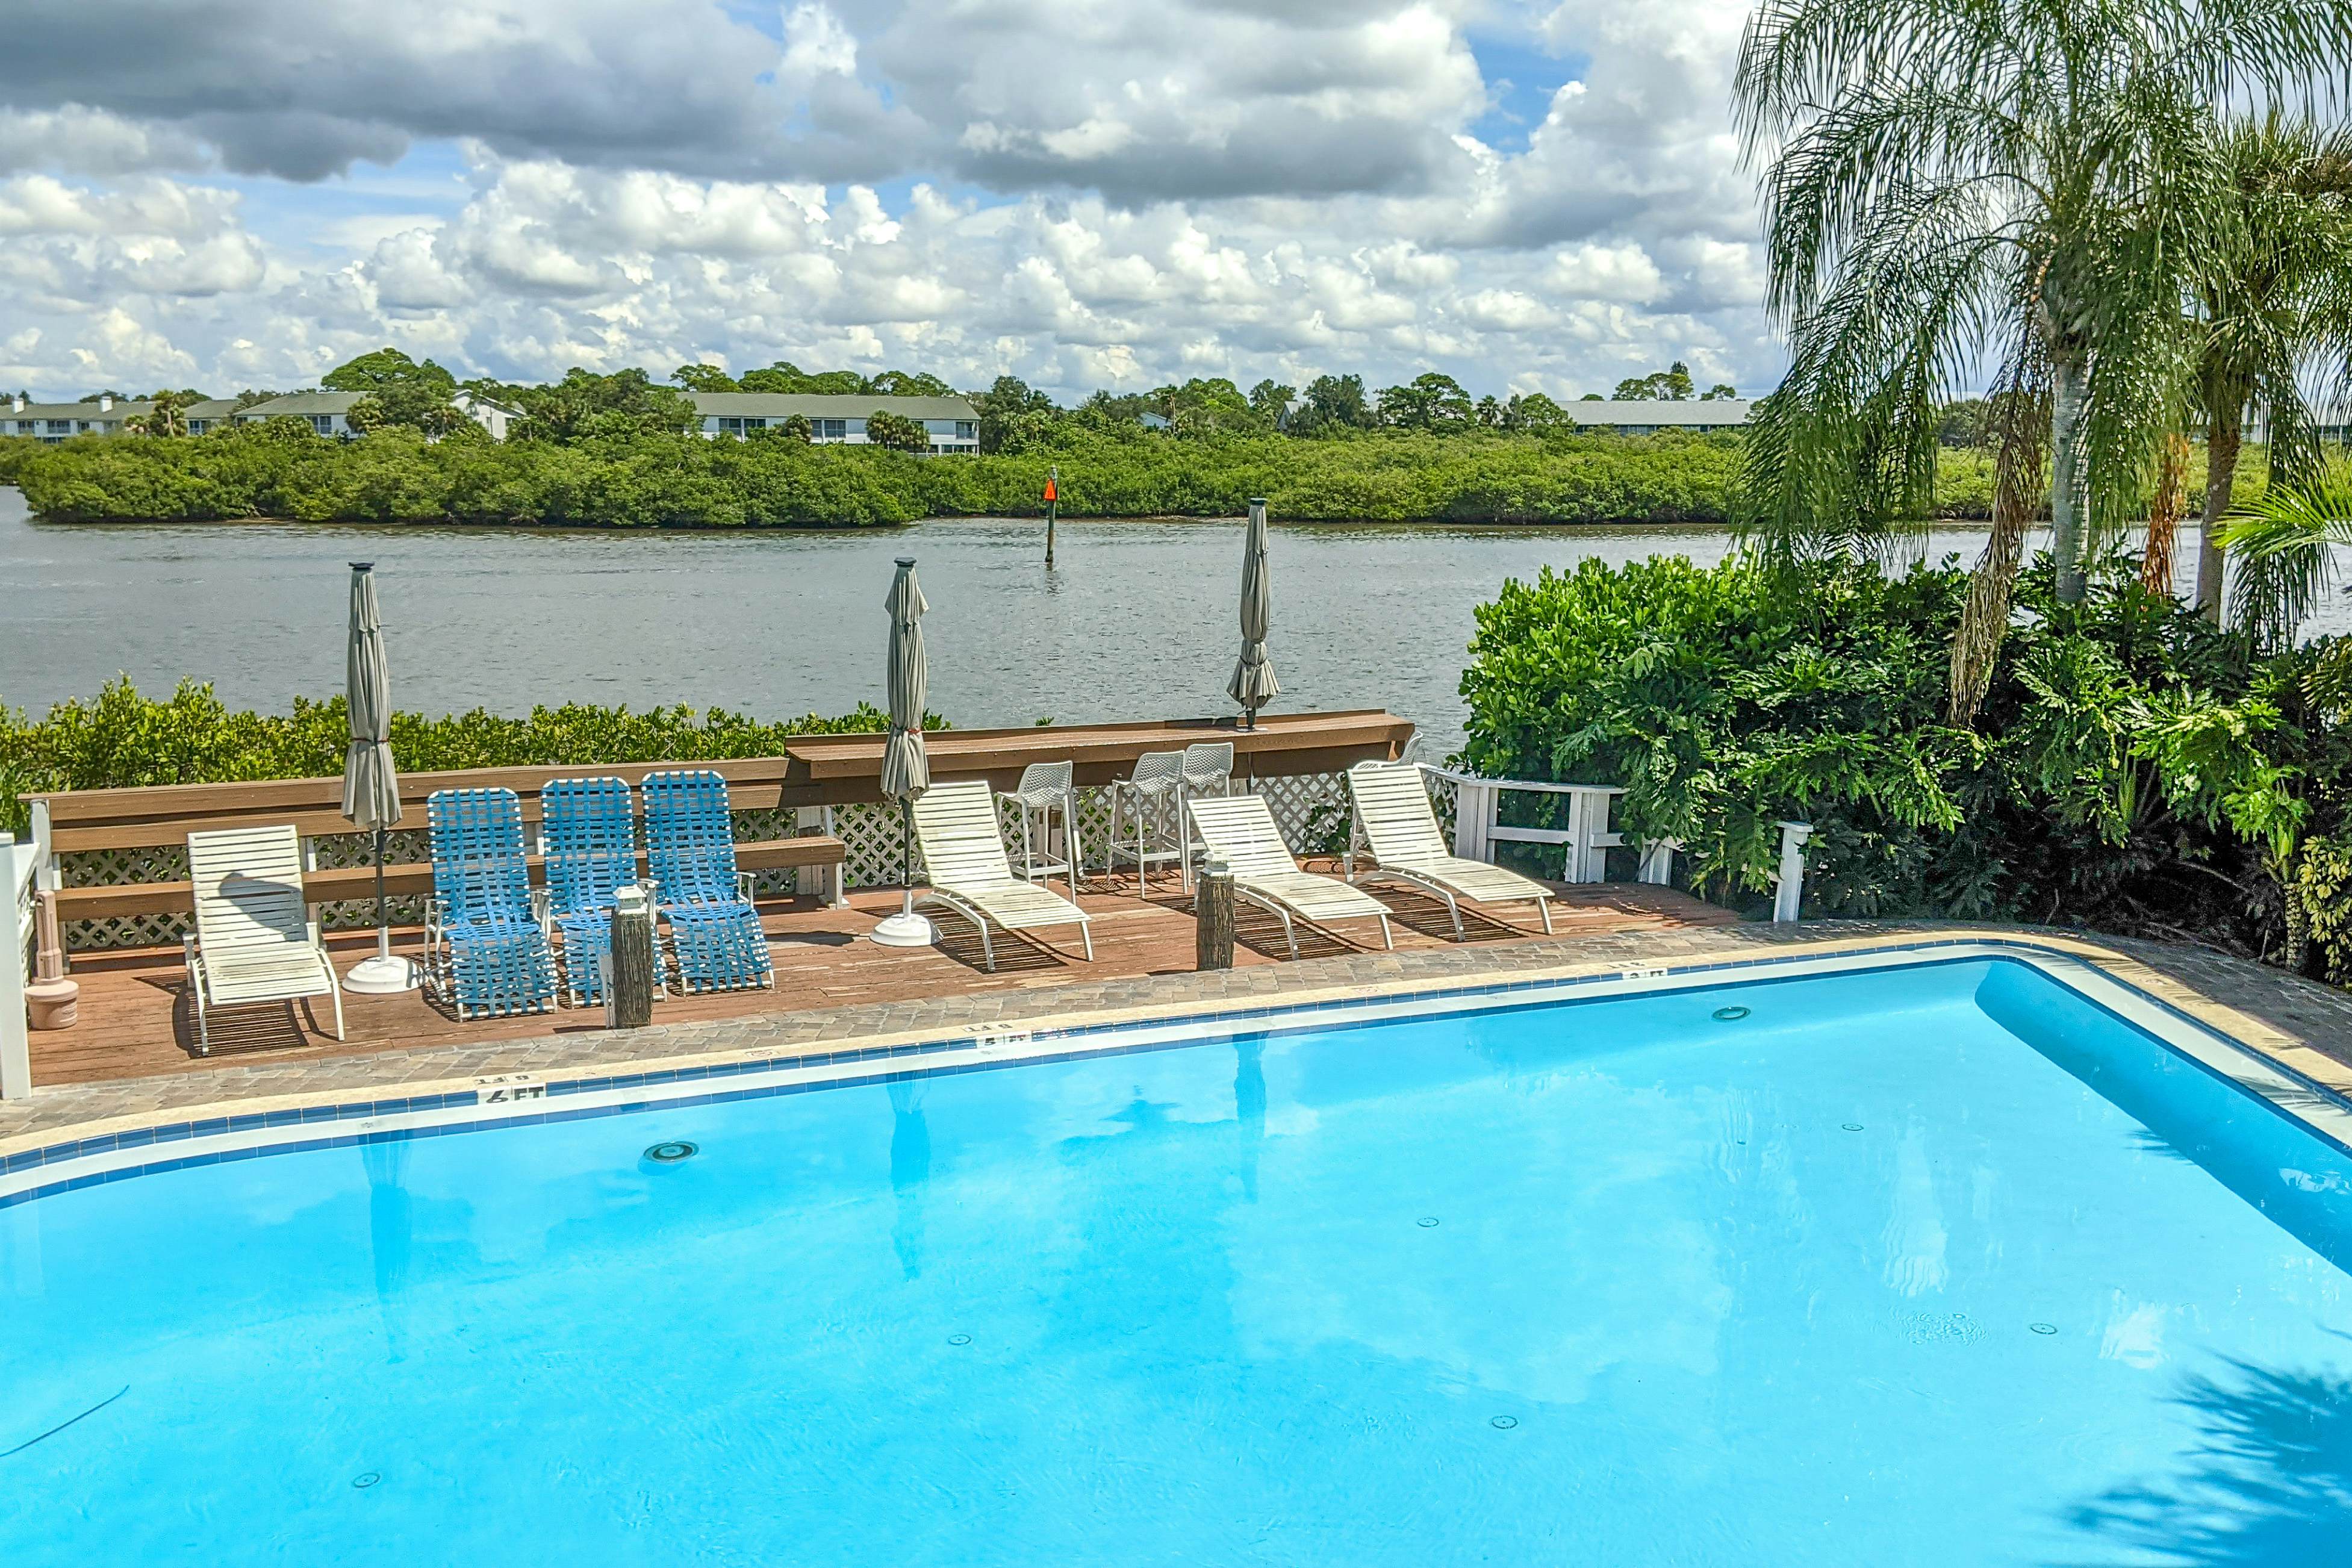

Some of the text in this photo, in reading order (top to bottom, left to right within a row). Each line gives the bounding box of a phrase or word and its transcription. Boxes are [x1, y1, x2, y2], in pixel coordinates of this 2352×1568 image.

[985, 1037, 995, 1045] 5
[486, 1086, 544, 1103] 6 FT
